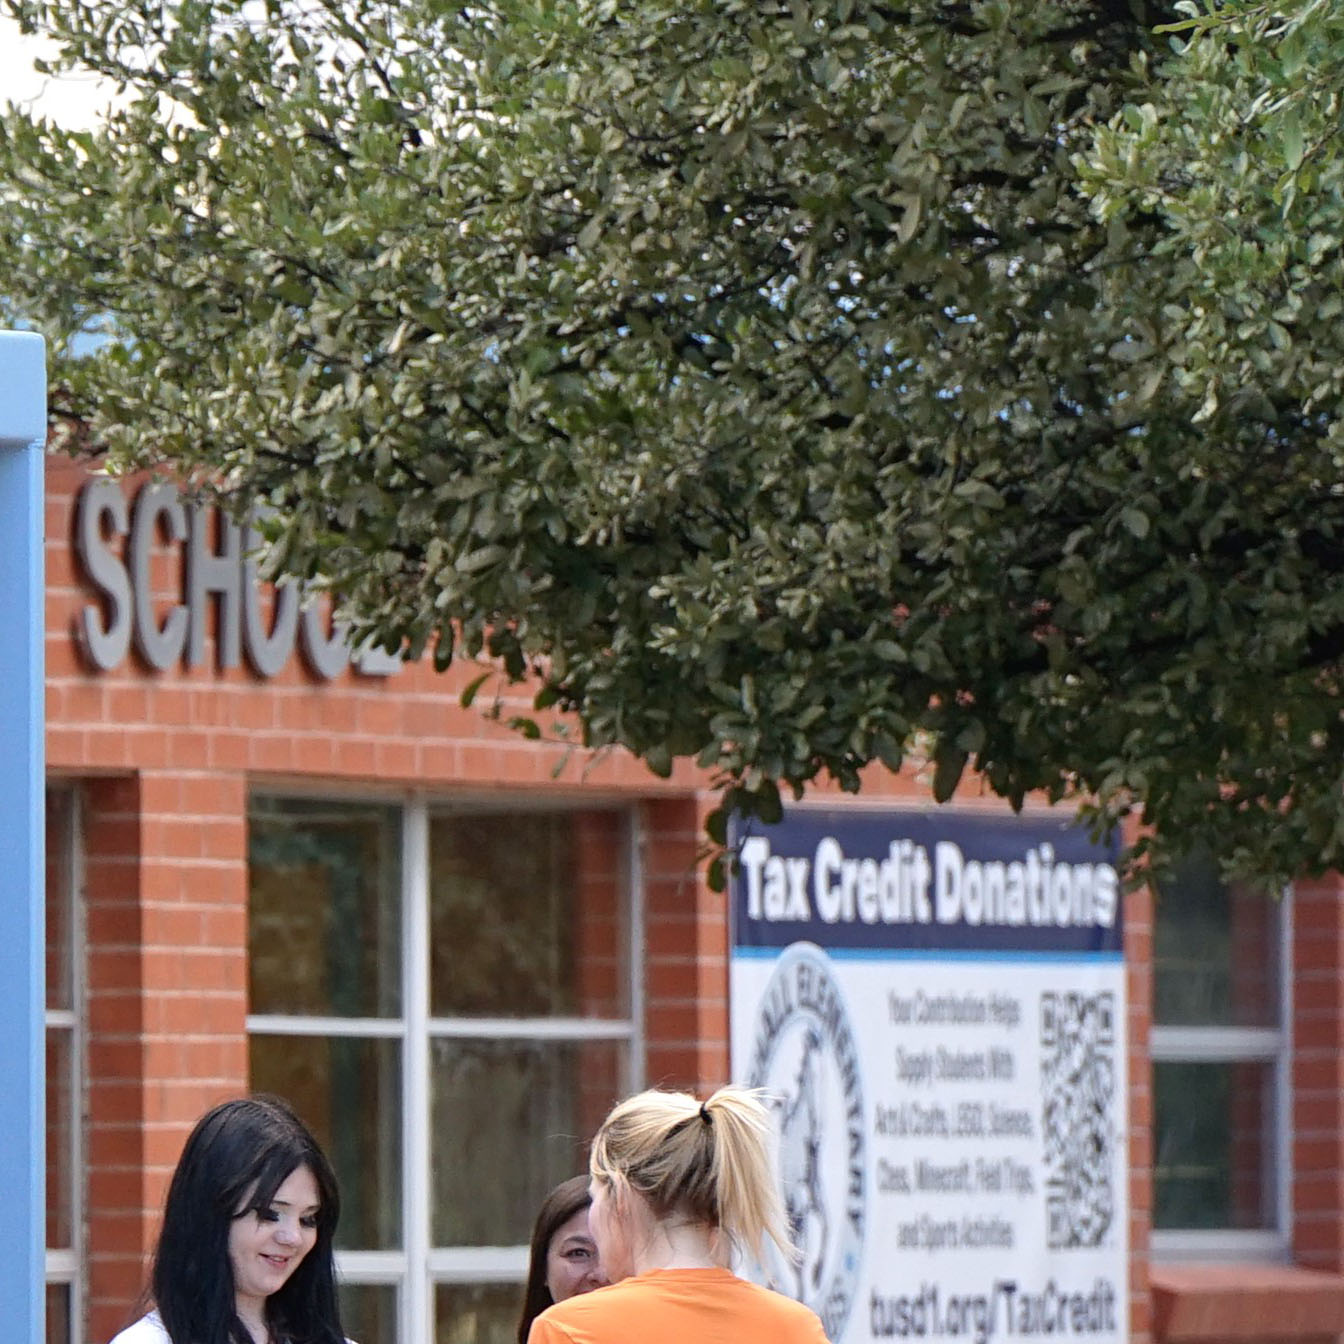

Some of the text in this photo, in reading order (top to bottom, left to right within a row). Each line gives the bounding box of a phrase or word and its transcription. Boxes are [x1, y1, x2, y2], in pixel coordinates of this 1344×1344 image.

[76, 480, 402, 681] SCHO
[741, 836, 1119, 929] Tax Credit Donations
[915, 988, 985, 1024] Contribution
